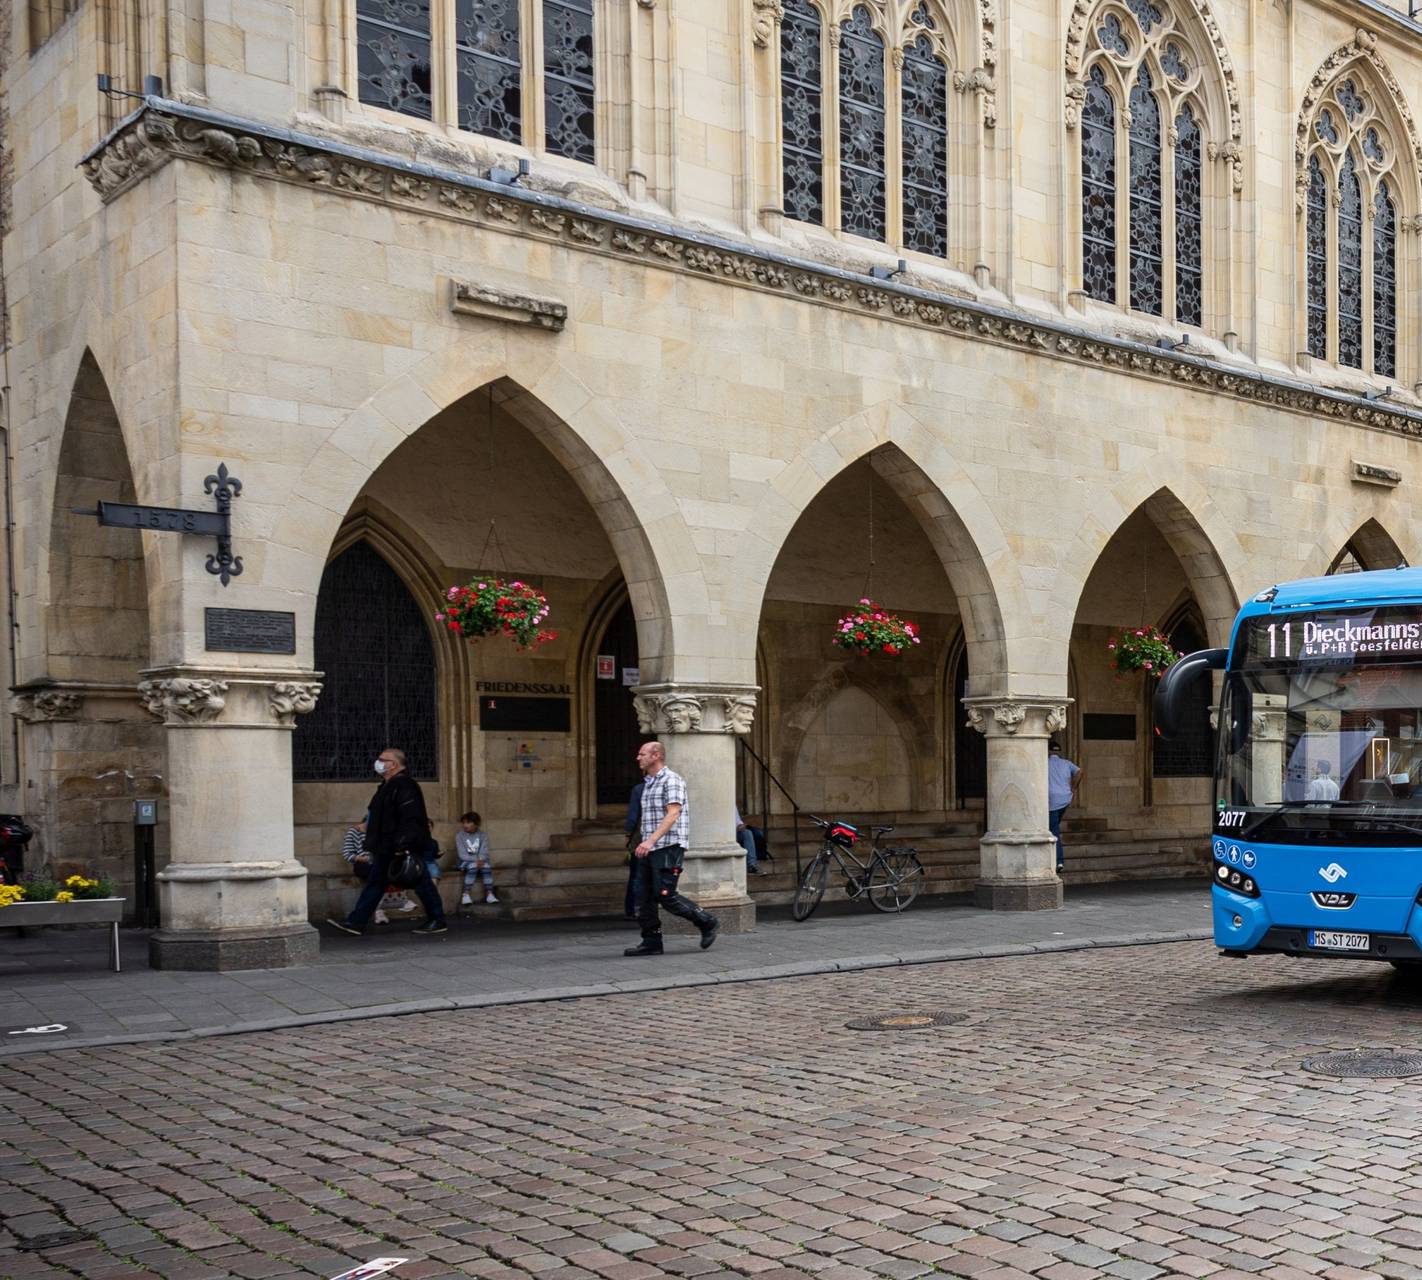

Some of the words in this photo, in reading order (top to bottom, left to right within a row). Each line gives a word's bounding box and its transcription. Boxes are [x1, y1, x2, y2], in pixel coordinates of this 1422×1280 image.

[1267, 622, 1292, 657] 11
[1305, 645, 1318, 655] ü.
[1321, 643, 1347, 654] P+R
[475, 681, 573, 694] FRIEDENSSAAL
[1218, 811, 1246, 827] 2077
[1318, 894, 1349, 904] VDL
[1314, 932, 1326, 945] MS
[1333, 934, 1344, 946] ST
[1346, 935, 1368, 948] 2077
